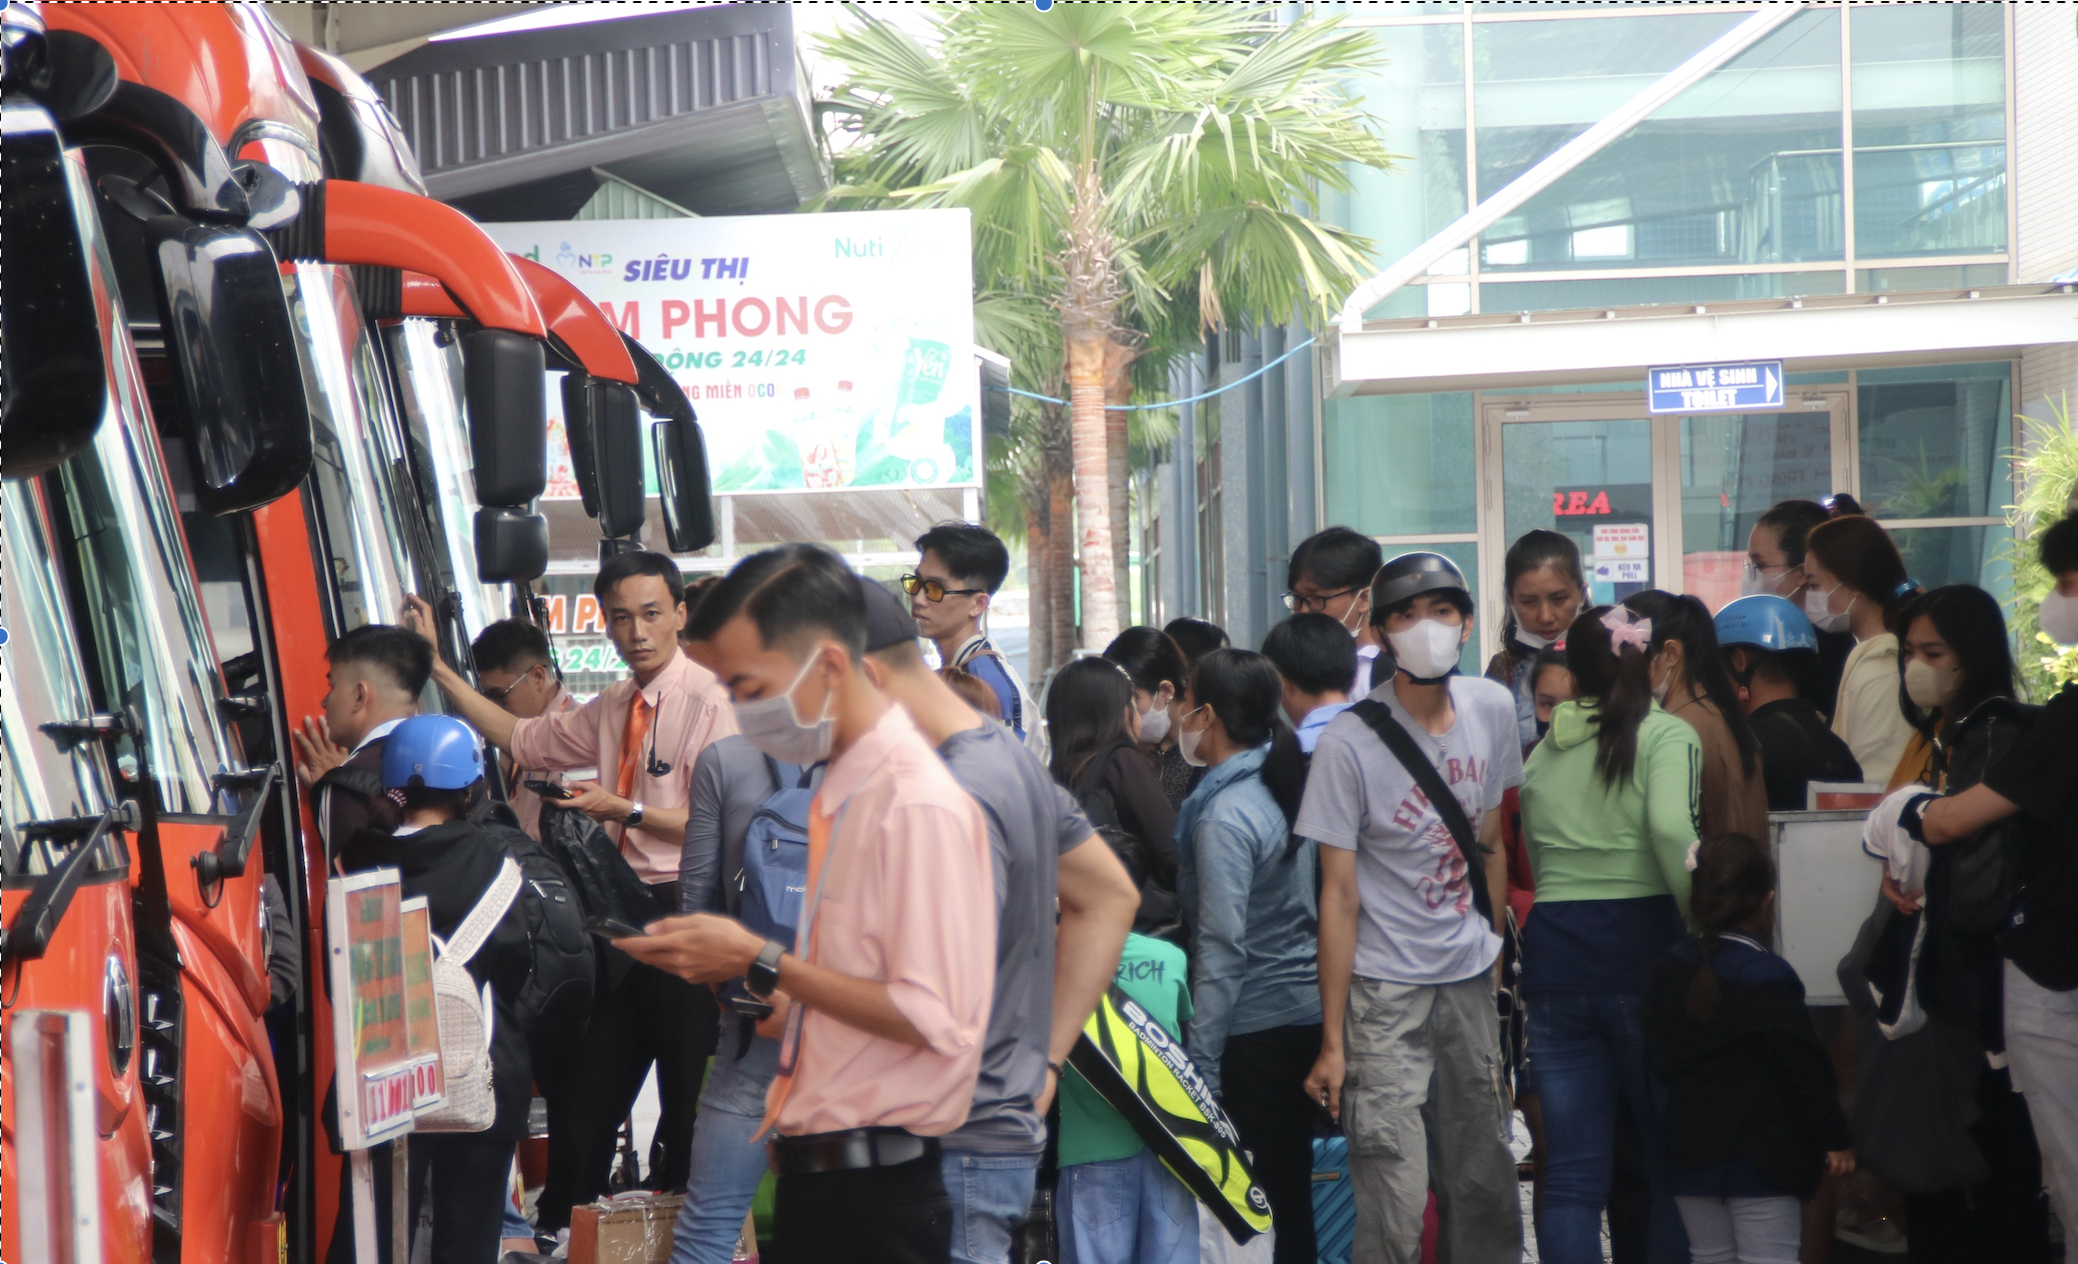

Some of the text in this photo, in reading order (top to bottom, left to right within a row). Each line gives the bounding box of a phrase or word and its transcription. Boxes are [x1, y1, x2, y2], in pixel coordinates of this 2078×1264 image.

[835, 237, 883, 258] Nuti
[579, 254, 613, 268] NTP
[623, 253, 749, 286] SIÊU THỊ
[661, 295, 853, 339] PHONG
[730, 349, 806, 369] 24/24
[1660, 368, 1757, 388] NHÀ VỆ SINH
[706, 379, 742, 399] MIỀN
[1681, 389, 1737, 408] TOILET
[1128, 1021, 1227, 1139] BADMINTON RACKET BSK-805
